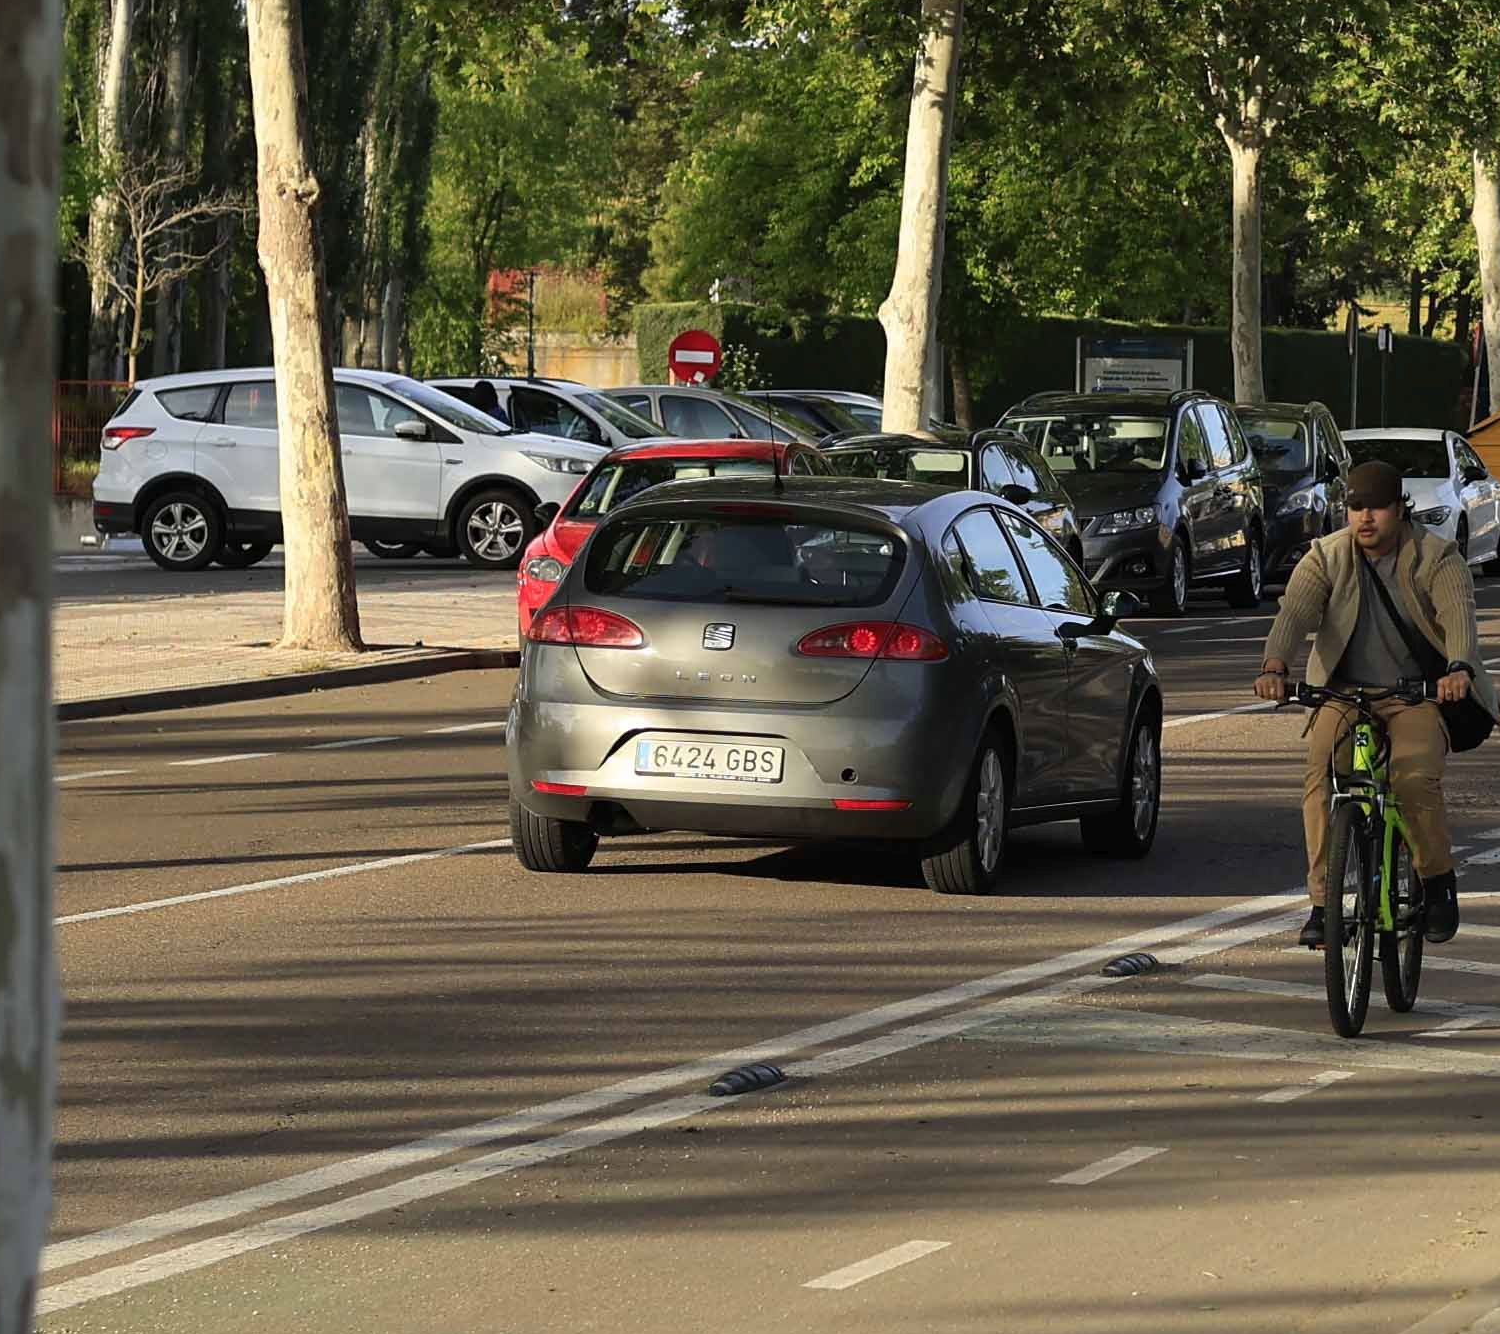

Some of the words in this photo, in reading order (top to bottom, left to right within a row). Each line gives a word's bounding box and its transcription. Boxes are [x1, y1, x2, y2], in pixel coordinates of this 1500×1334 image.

[675, 670, 757, 684] LEON
[654, 745, 716, 770] 6424
[726, 748, 775, 772] GBS
